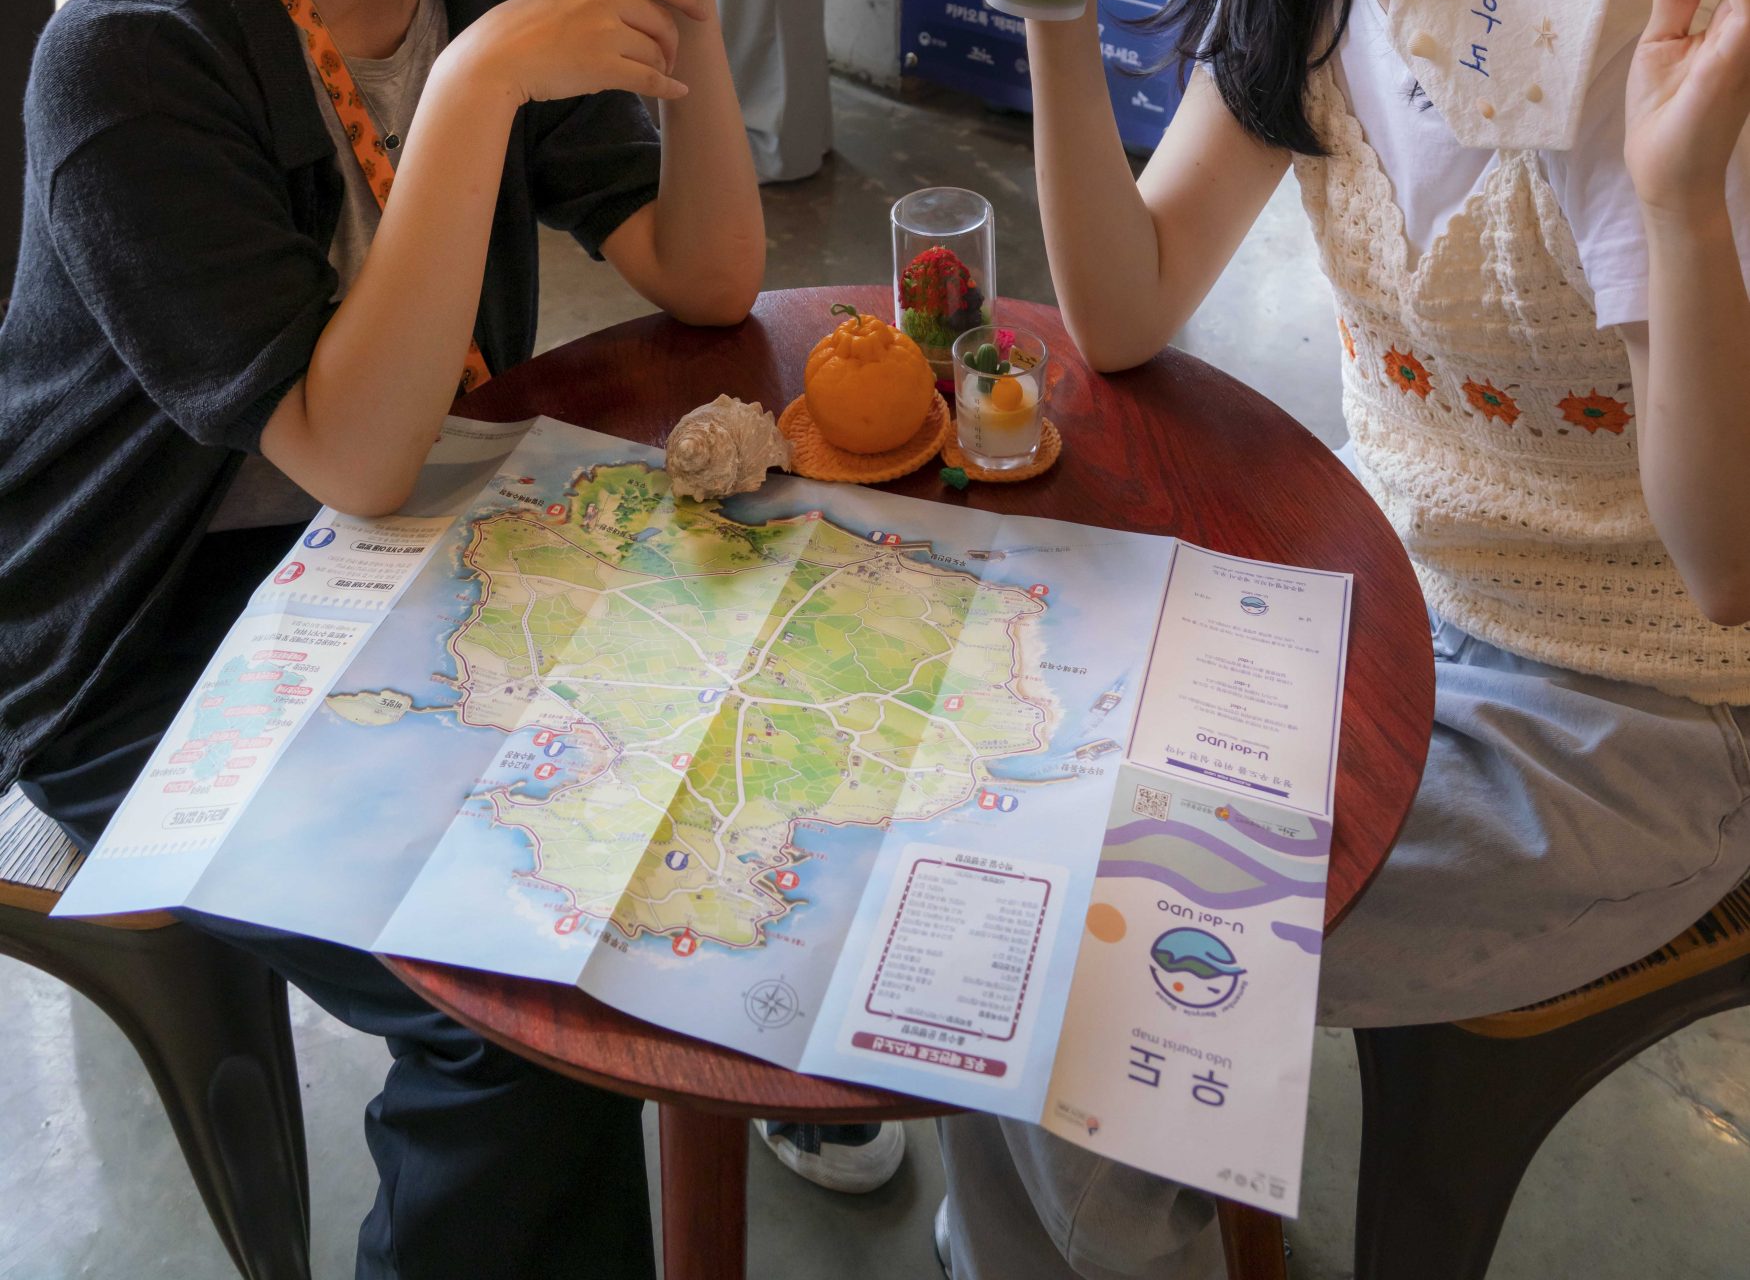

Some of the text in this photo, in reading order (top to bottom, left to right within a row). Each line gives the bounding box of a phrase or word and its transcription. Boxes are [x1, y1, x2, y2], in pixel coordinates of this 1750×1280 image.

[945, 2, 989, 26] 카카오톡
[335, 579, 353, 588] 방법
[379, 697, 403, 710] 비양도
[1196, 733, 1228, 750] UDO
[1165, 744, 1185, 757] 서약
[1230, 742, 1269, 761] U-do!
[1213, 759, 1233, 771] 위한
[1238, 766, 1268, 782] 우도를
[1156, 898, 1246, 935] U-do! UDO
[872, 1037, 917, 1059] 버스노선
[1131, 1027, 1233, 1070] Udo tourist map
[963, 1056, 988, 1073] 우도
